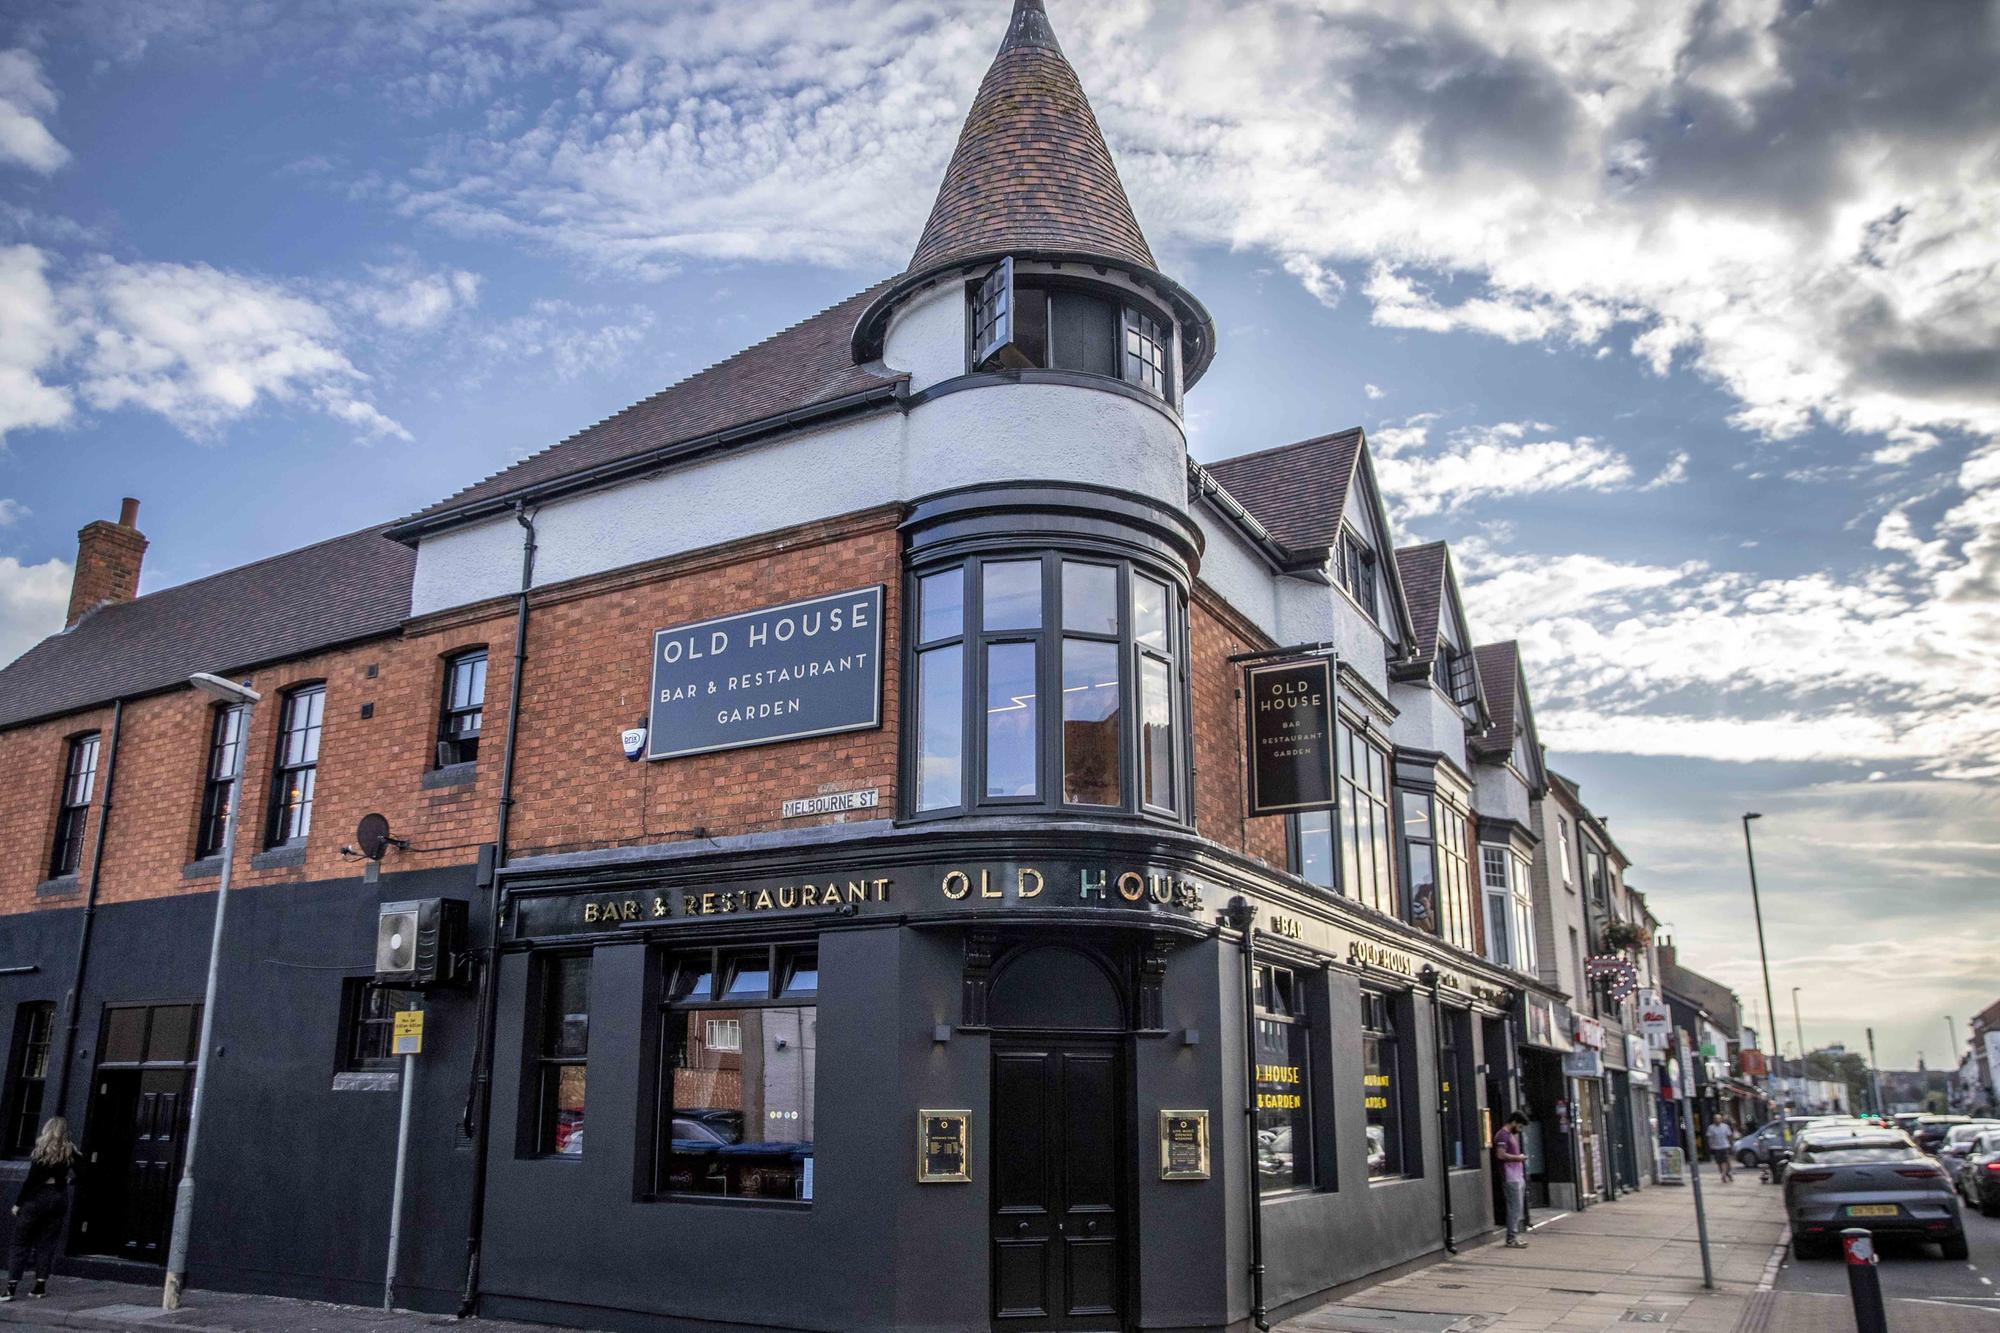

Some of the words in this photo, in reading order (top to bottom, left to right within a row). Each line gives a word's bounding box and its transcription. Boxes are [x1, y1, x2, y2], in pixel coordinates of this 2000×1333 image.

[663, 631, 729, 663] OLD
[749, 602, 869, 648] HOUSE
[660, 684, 697, 703] BAR
[707, 681, 717, 694] &
[728, 653, 867, 691] RESTAURANT
[1271, 681, 1308, 695] OLD
[717, 698, 800, 725] GARDEN
[1261, 694, 1321, 712] HOUSE
[1282, 720, 1301, 729] BAR
[1262, 732, 1323, 745] RESTAURANT
[1273, 747, 1311, 758] GARDEN
[784, 794, 854, 817] MELBOURNE
[860, 791, 875, 806] ST
[584, 900, 643, 923] BAR
[653, 897, 667, 917] &
[683, 878, 891, 916] RESTAURANT
[942, 868, 1045, 901] OLD
[1080, 868, 1205, 912] HOUSE
[1280, 915, 1304, 940] BAR
[1356, 941, 1380, 965] OLD
[1265, 1064, 1299, 1084] HOUSE
[1265, 1094, 1301, 1109] GARDEN
[1364, 1096, 1388, 1109] ARDEN
